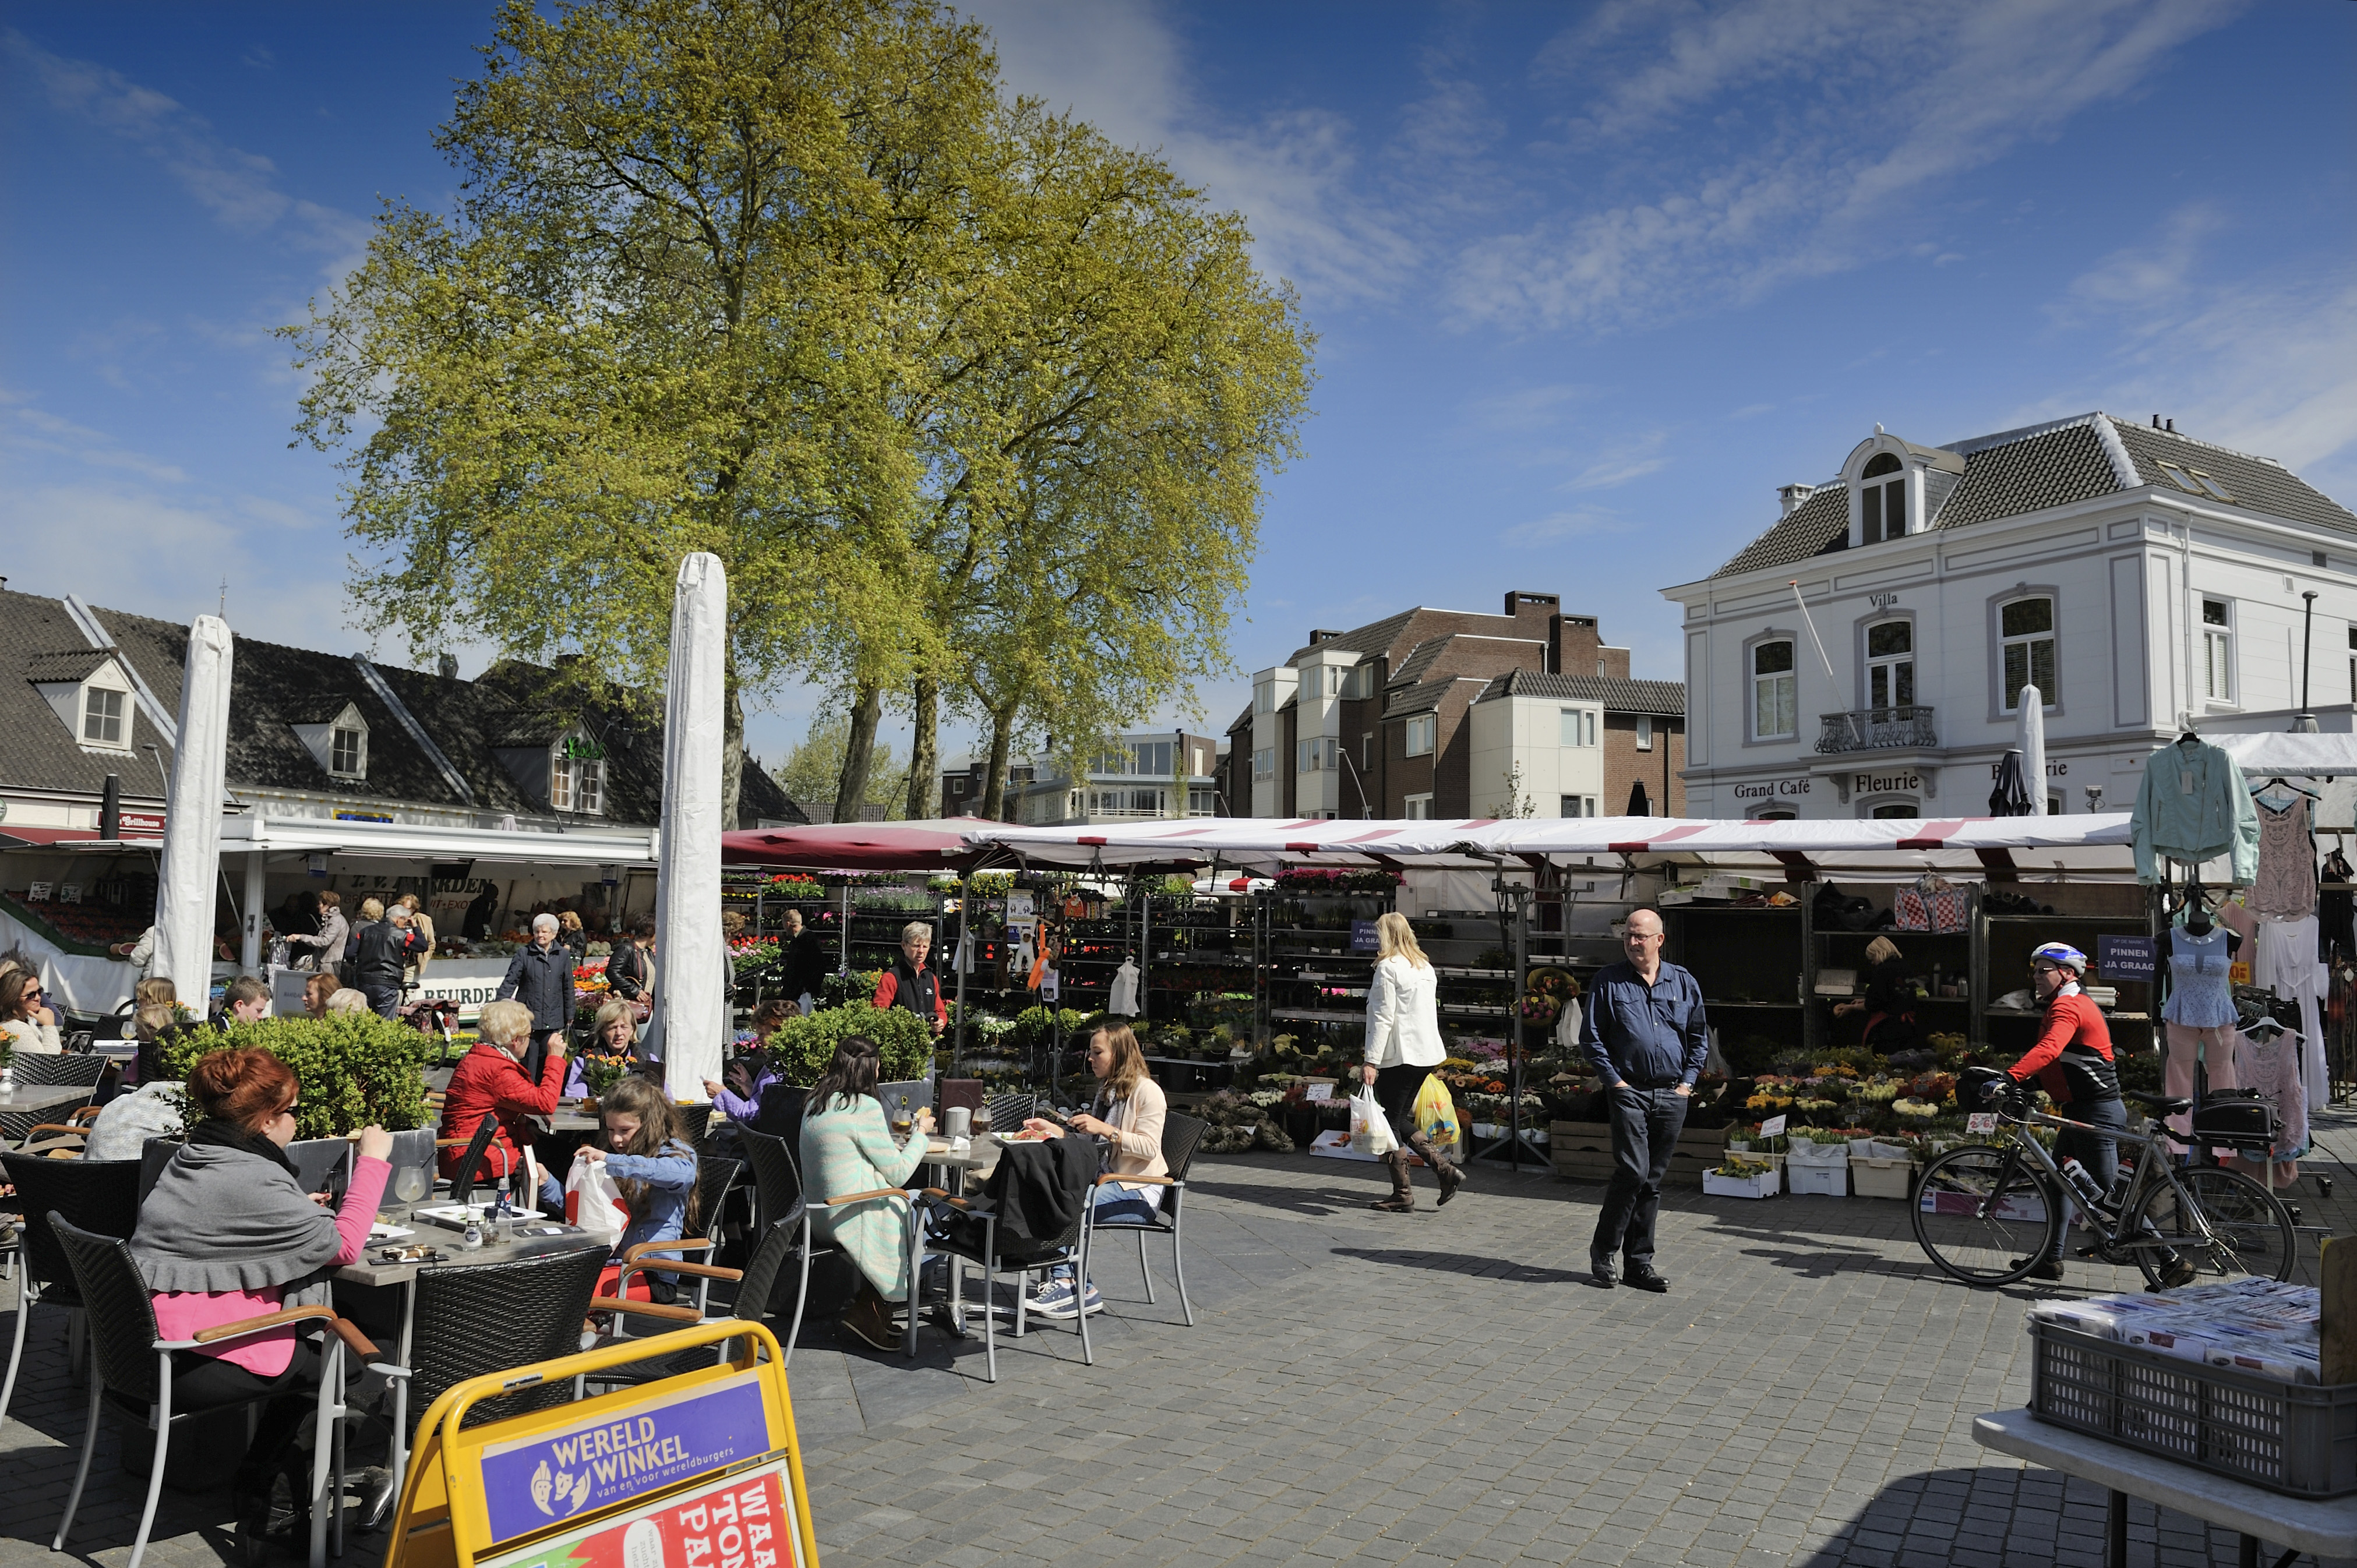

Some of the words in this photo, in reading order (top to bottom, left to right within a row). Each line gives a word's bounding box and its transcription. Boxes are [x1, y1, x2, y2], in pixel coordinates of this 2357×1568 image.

[1869, 593, 1898, 607] Villa
[1734, 783, 1774, 797] Grand
[1780, 779, 1810, 795] Café
[1855, 772, 1918, 793] Fleurie
[122, 815, 160, 827] Grillhouse
[448, 900, 471, 909] EXO
[2110, 948, 2148, 958] PINNEN
[2120, 961, 2155, 971] GRAAG
[424, 988, 499, 1005] BEURDE
[552, 1417, 655, 1468] WERELD
[592, 1435, 689, 1485] WINKEL
[597, 1486, 616, 1498] van
[620, 1480, 632, 1490] en
[635, 1472, 659, 1485] voor
[662, 1447, 734, 1477] wereldburgers
[740, 1481, 778, 1568] WAA
[679, 1503, 714, 1568] PA
